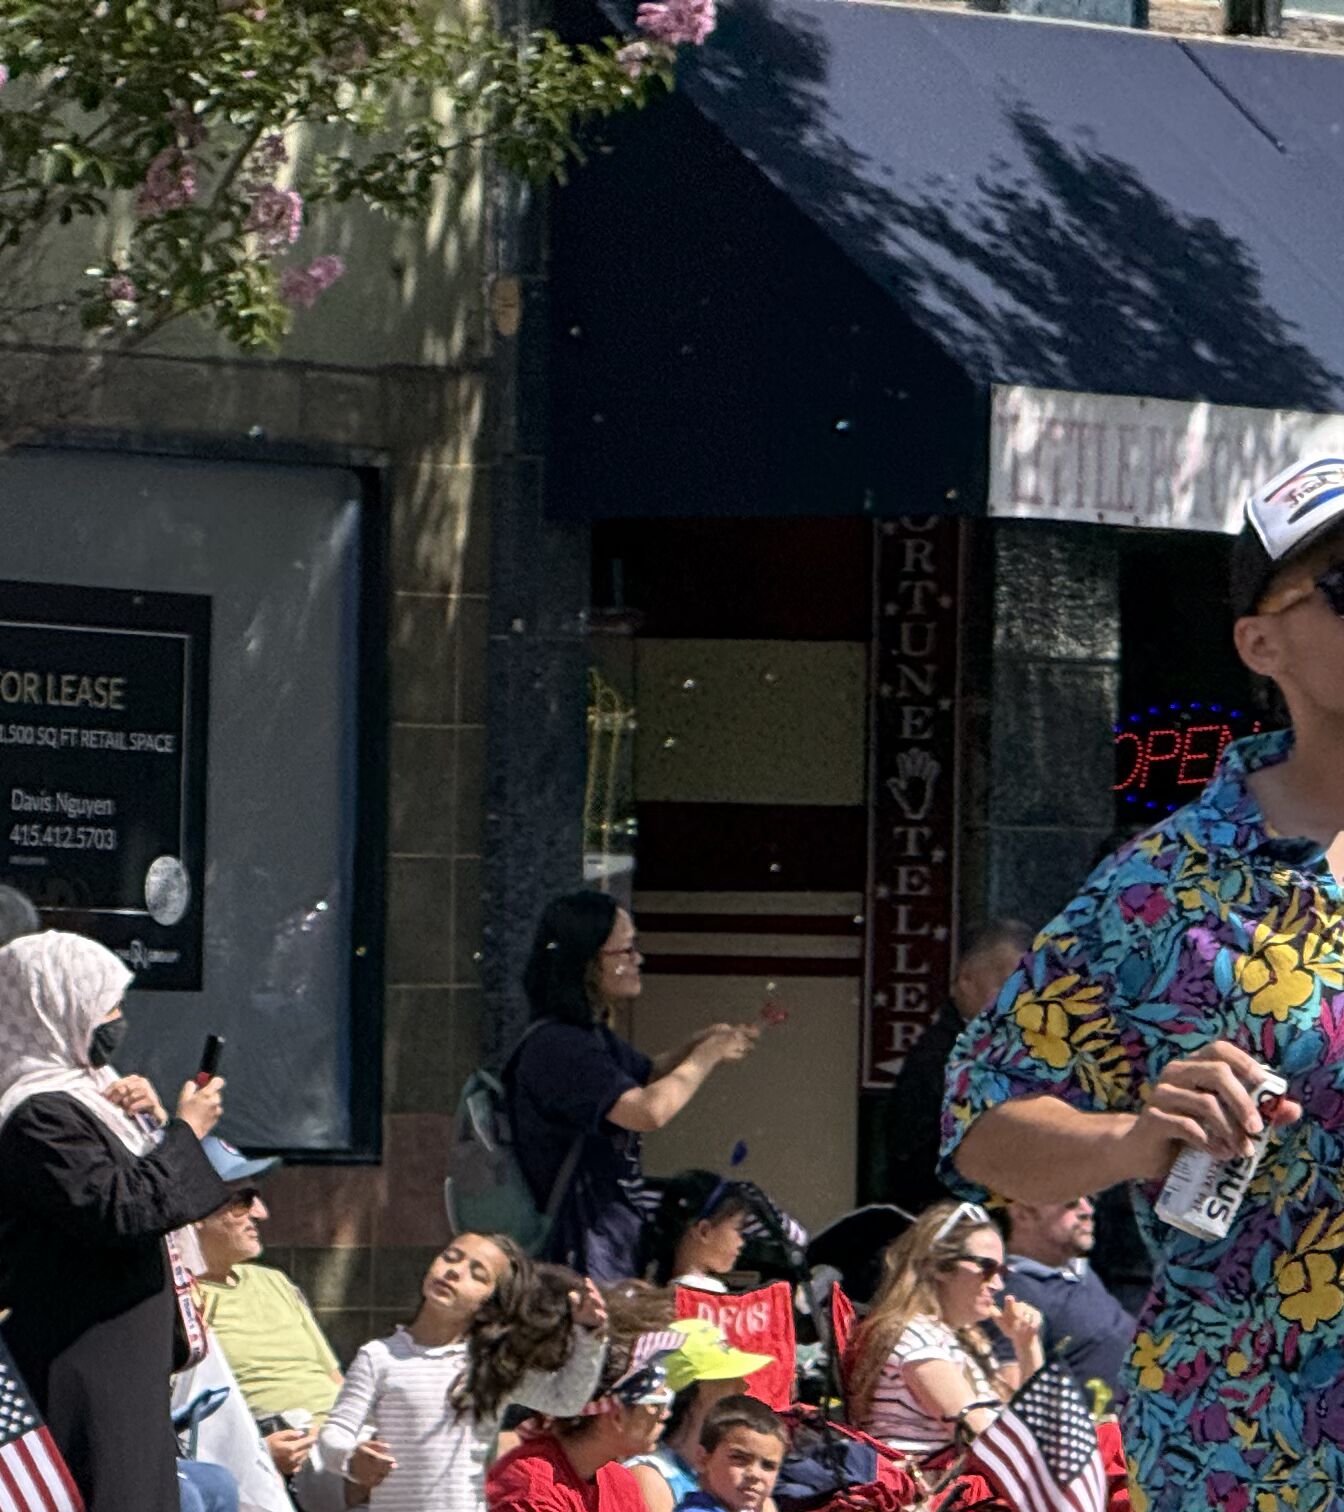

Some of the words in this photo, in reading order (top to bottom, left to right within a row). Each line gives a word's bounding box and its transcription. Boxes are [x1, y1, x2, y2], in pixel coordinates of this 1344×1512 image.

[47, 673, 127, 710] LEASE
[36, 726, 60, 749] SQ
[60, 728, 77, 747] FT
[80, 729, 129, 750] RETAIL
[129, 732, 176, 753] SPACE
[11, 789, 52, 812] Davis
[55, 792, 115, 819] Nguyen
[9, 824, 117, 850] 415.412.5703
[891, 826, 933, 1051] TELLER
